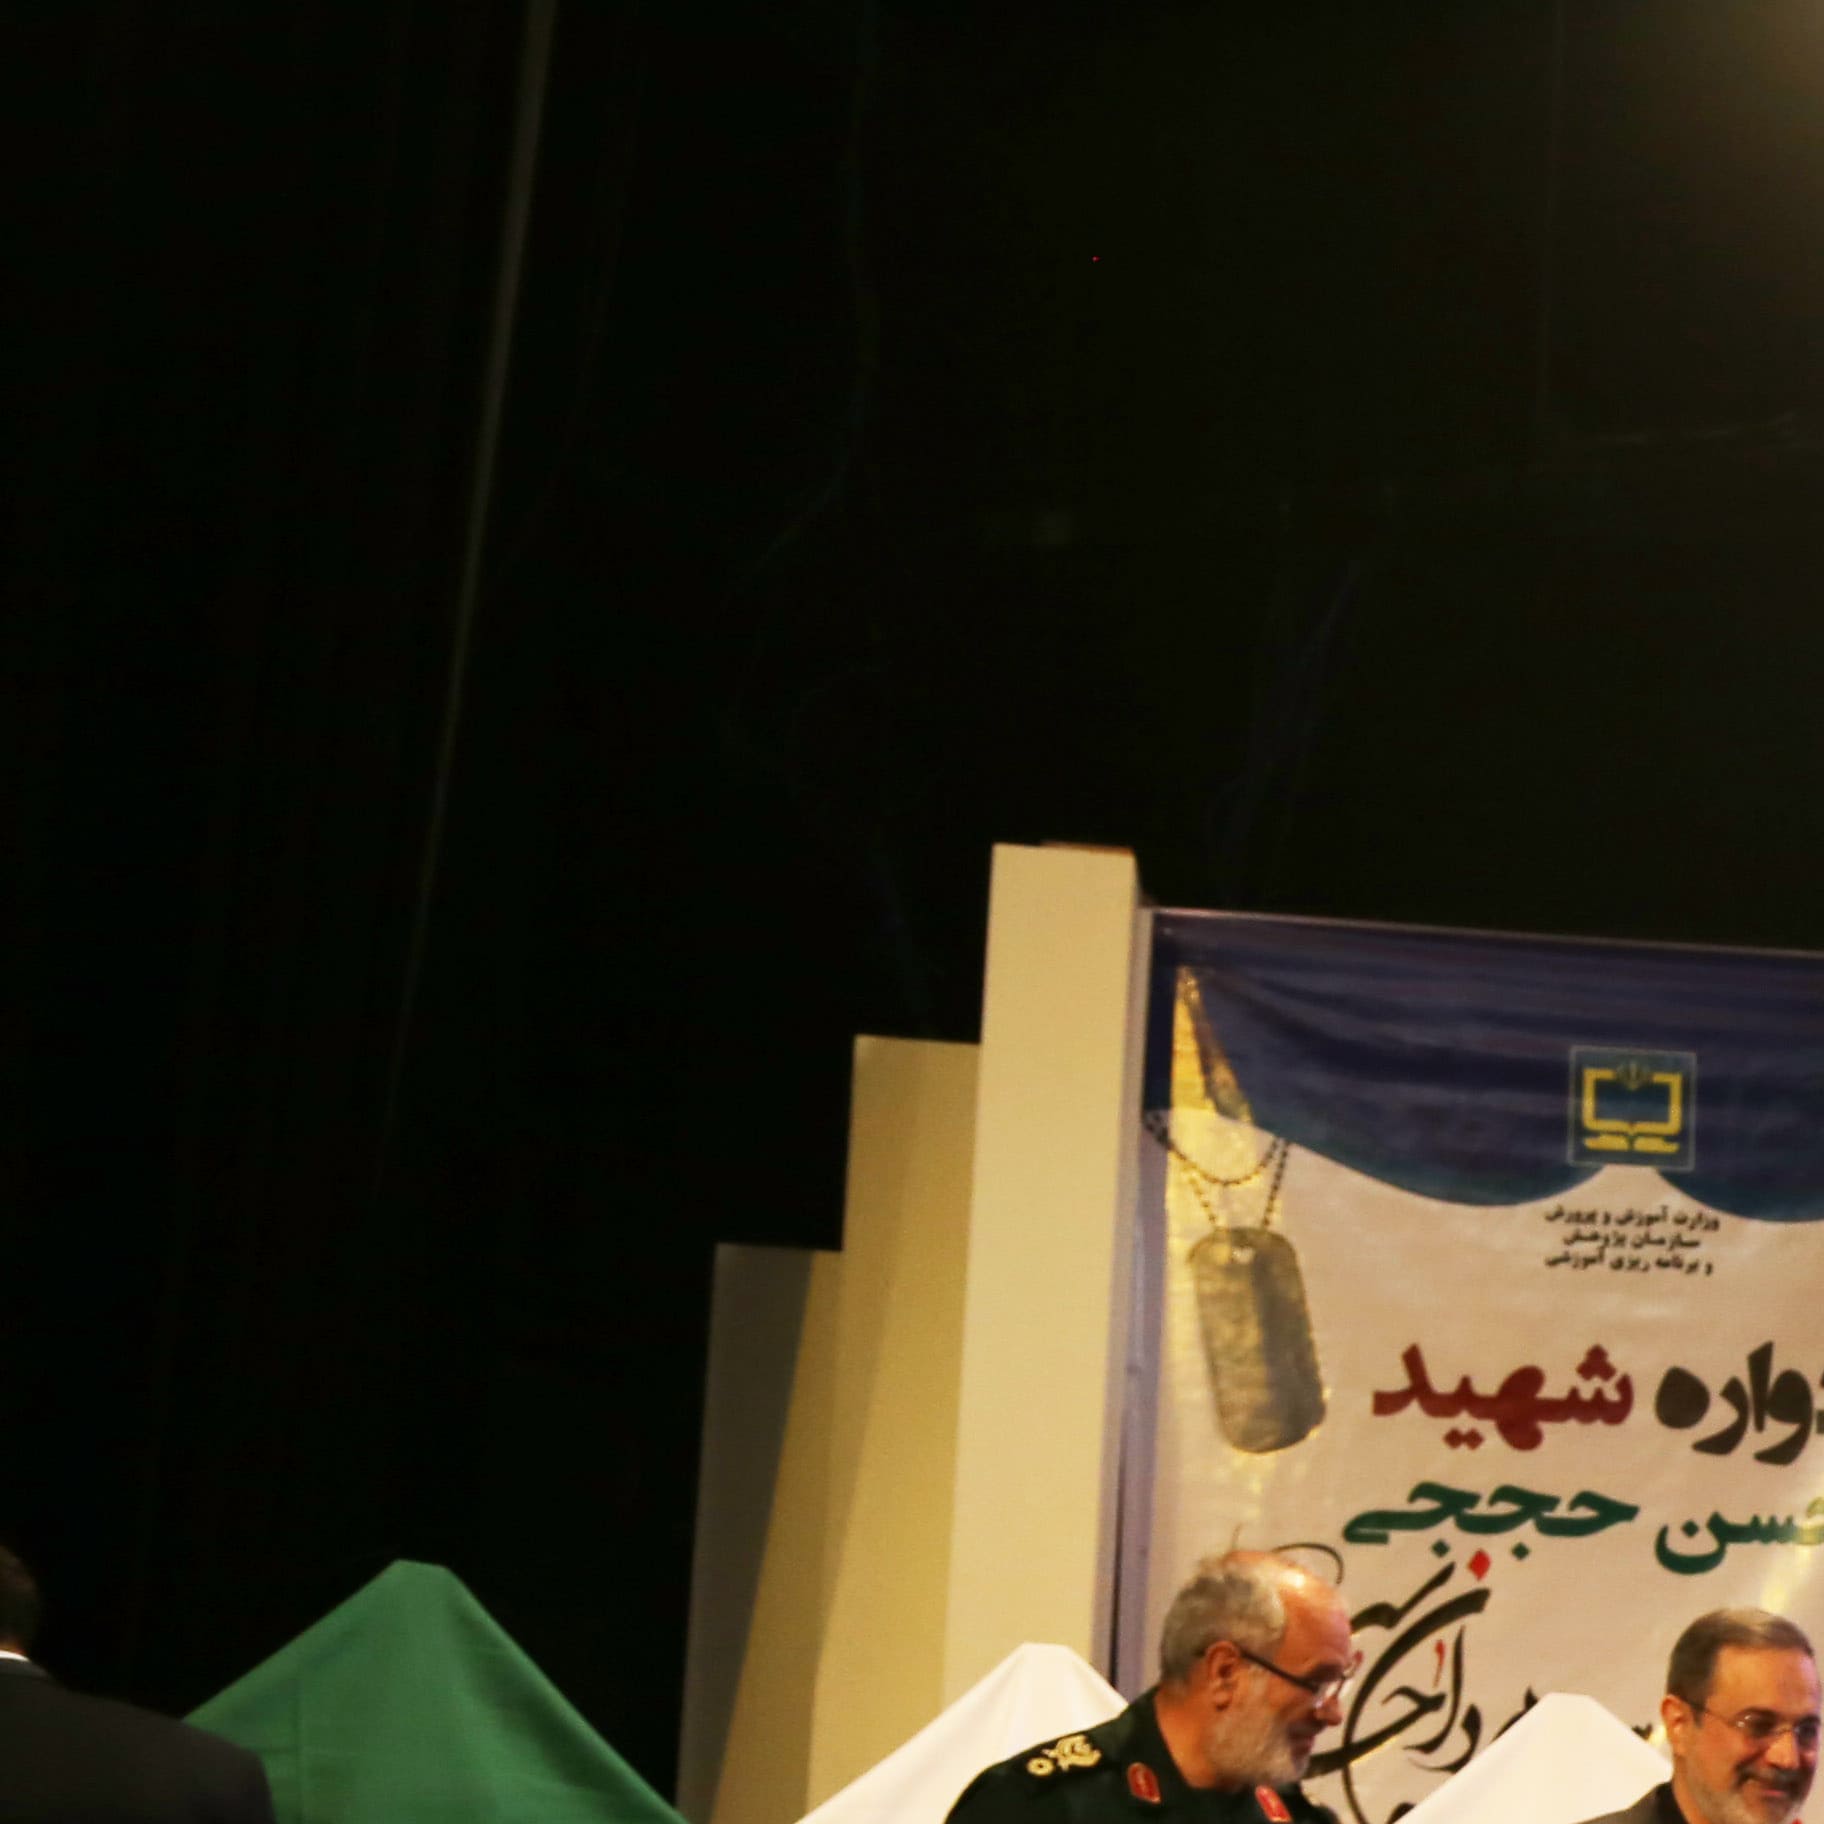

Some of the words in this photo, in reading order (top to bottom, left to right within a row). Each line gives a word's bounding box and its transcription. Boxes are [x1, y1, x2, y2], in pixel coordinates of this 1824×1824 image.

[1545, 1206, 1598, 1225] پرورش
[1615, 1206, 1668, 1228] آموزش
[1672, 1211, 1721, 1232] وزارت
[1563, 1229, 1627, 1250] پژوهش
[1631, 1232, 1701, 1252] سازمان
[1545, 1244, 1609, 1270] آموزشی
[1610, 1257, 1650, 1272] ریزی
[1655, 1255, 1699, 1274] برنامه
[1372, 1343, 1634, 1452] شهید
[1343, 1481, 1640, 1561] حججی
